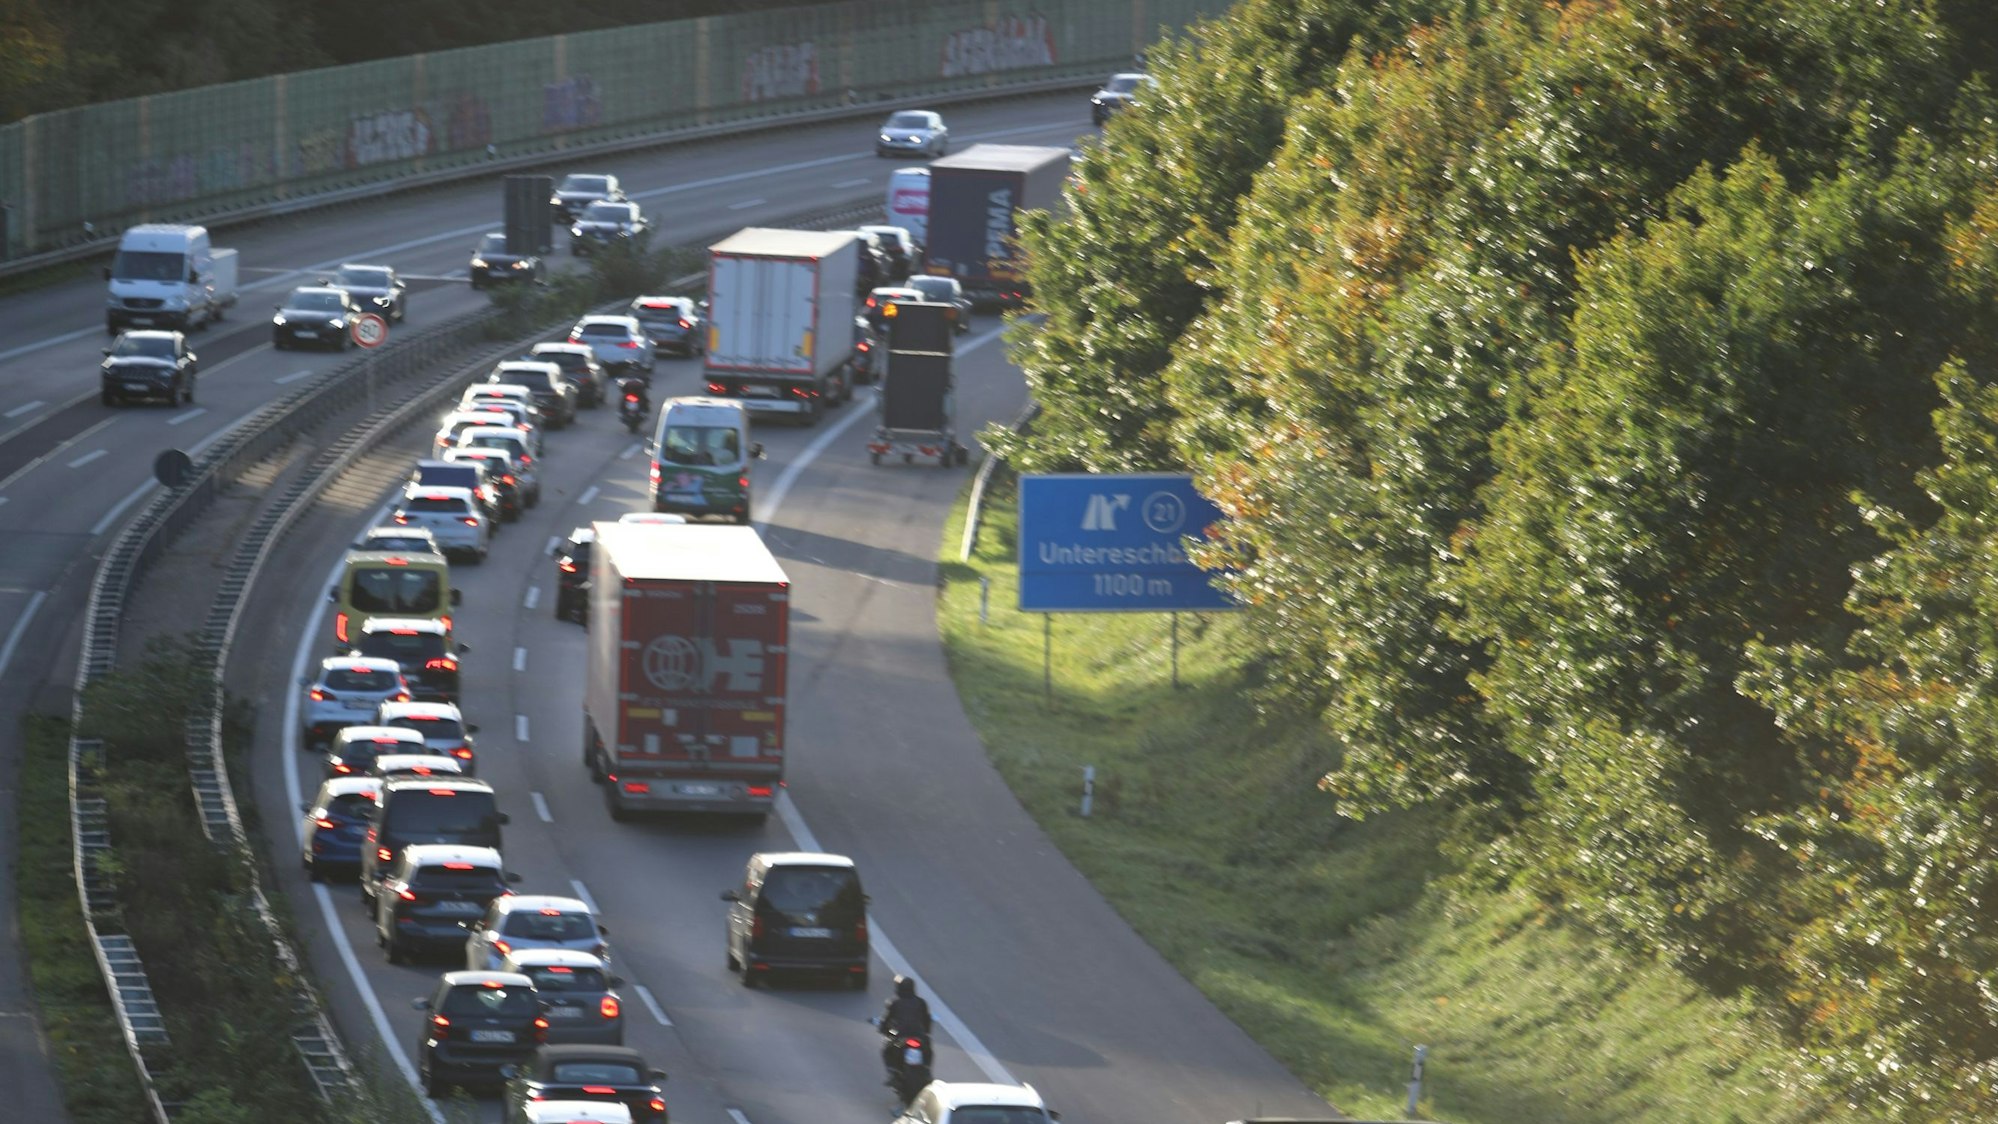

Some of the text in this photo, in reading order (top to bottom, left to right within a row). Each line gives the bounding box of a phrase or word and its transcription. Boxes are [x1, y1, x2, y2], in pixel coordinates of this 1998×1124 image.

[1153, 502, 1175, 522] 21
[1038, 541, 1184, 565] Untereschb
[1093, 573, 1173, 596] 1100 m
